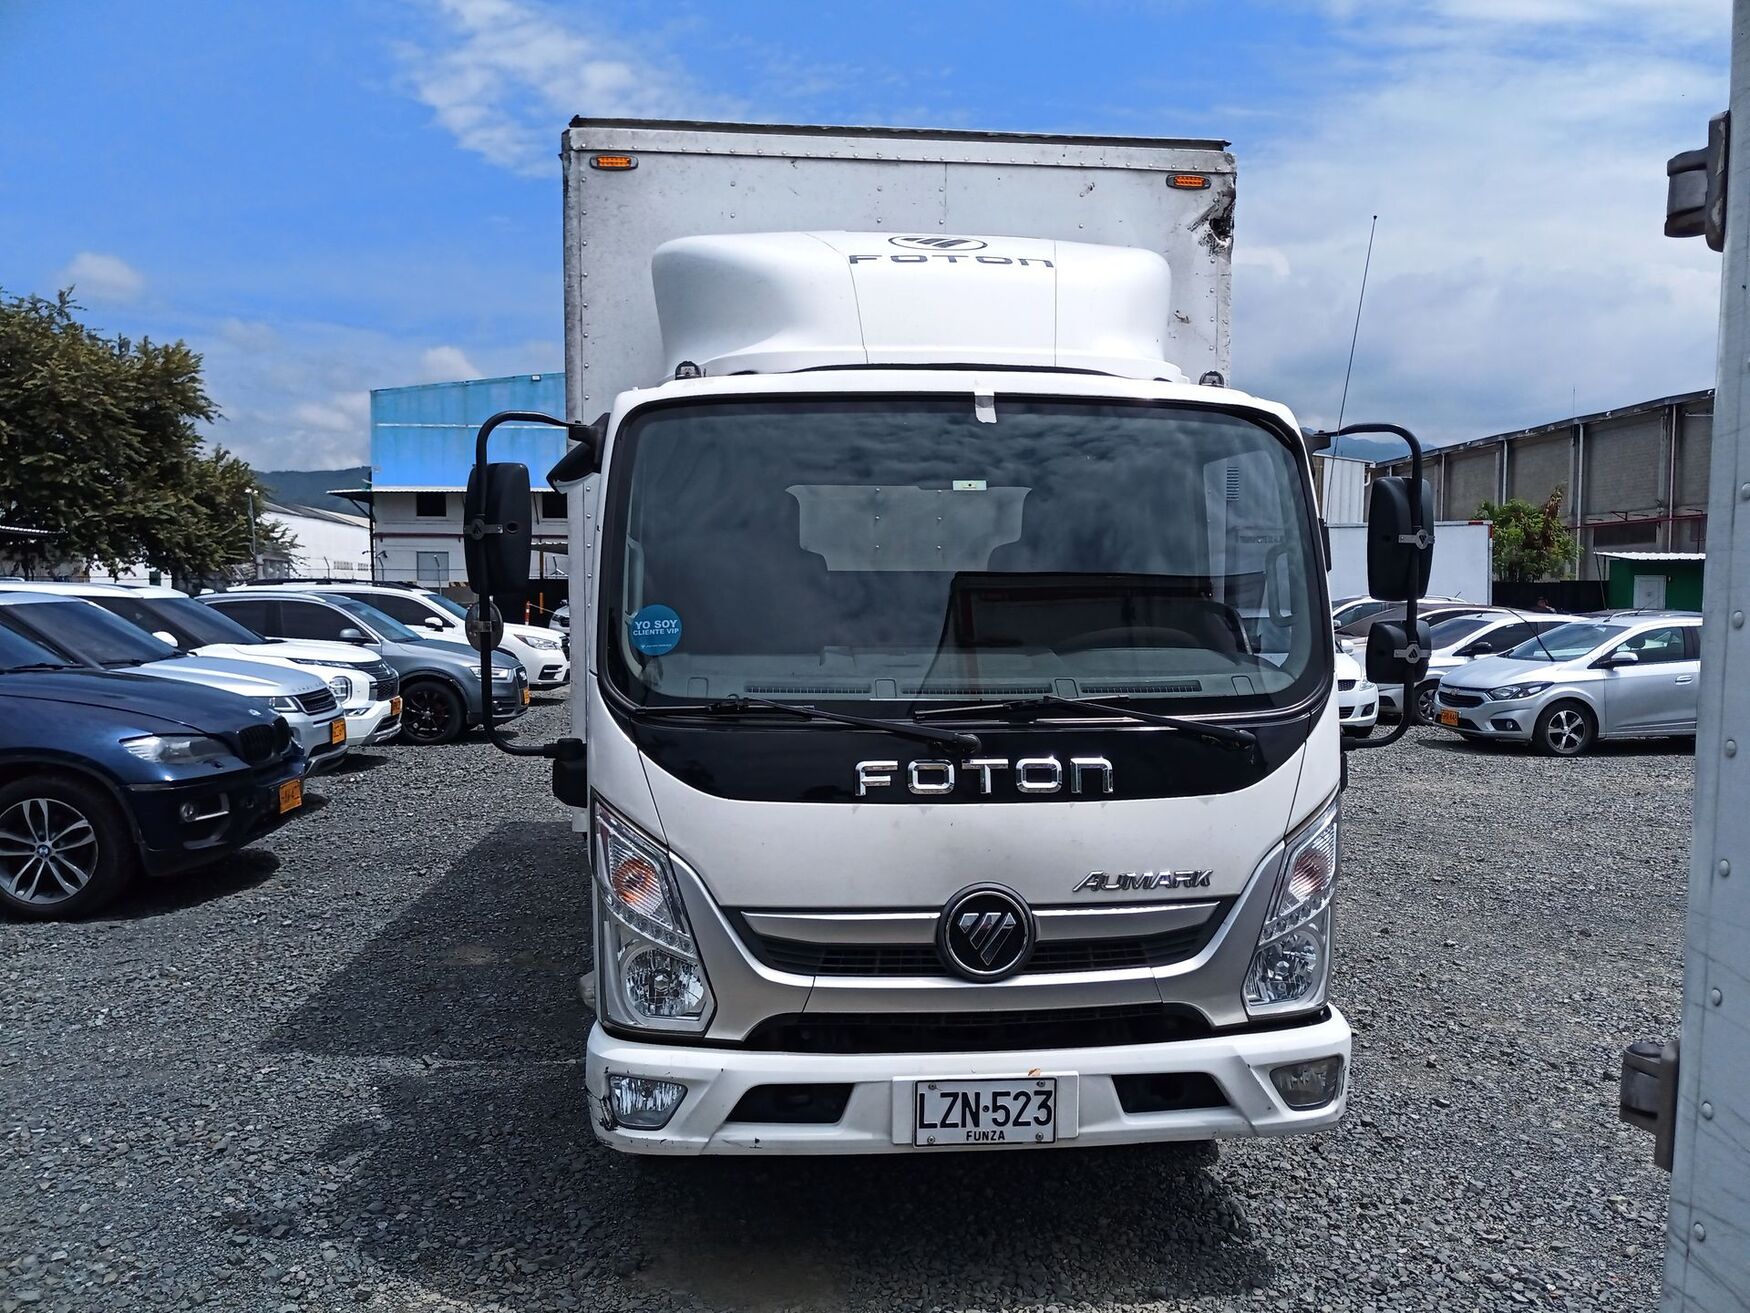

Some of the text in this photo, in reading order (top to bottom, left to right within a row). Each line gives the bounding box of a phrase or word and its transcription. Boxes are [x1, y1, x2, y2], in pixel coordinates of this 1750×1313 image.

[635, 619, 678, 630] YO SOY
[632, 628, 665, 636] CLIENTE
[1072, 869, 1213, 893] AUMARK
[966, 1130, 1006, 1142] FUNZA
